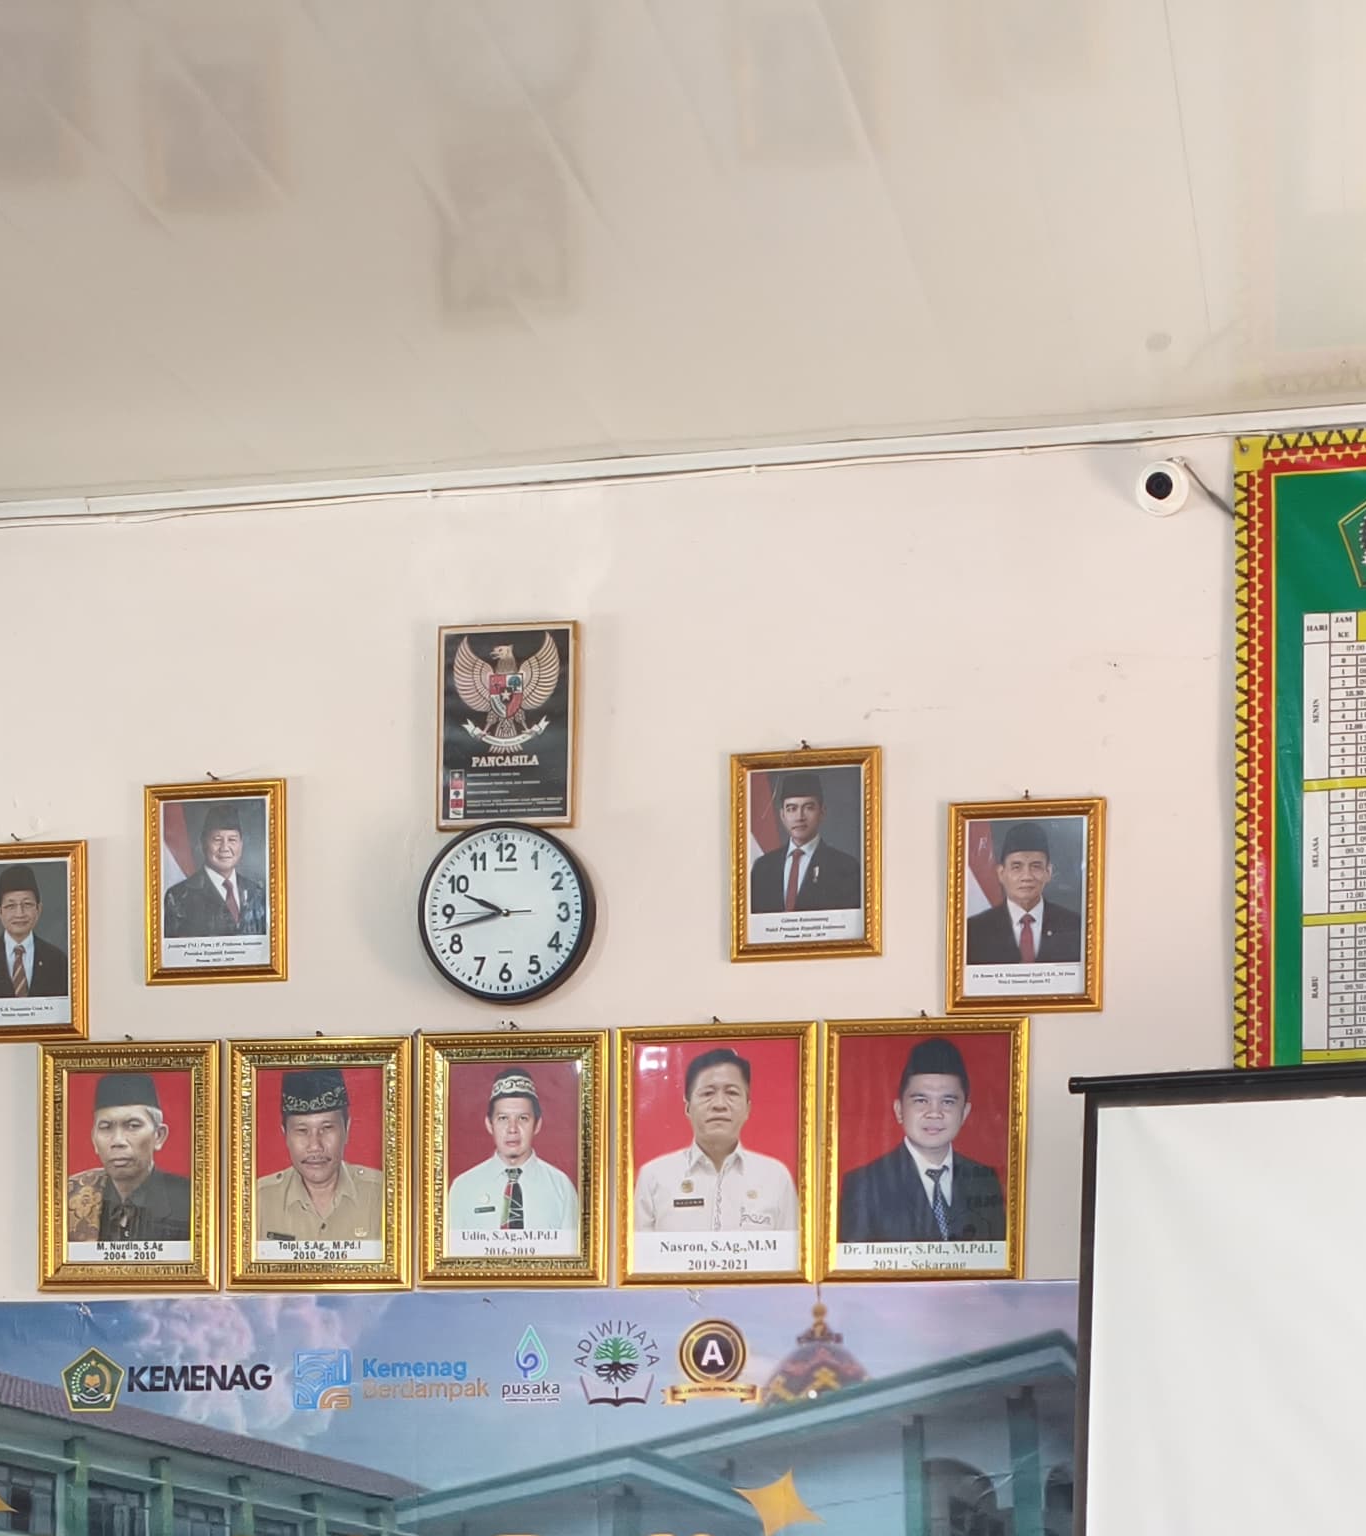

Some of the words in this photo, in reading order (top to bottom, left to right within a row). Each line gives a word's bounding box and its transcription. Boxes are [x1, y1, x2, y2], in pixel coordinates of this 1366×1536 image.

[1306, 624, 1328, 632] HARI
[471, 755, 539, 767] PANCASILA
[470, 852, 487, 871] 11
[495, 843, 516, 861] 12
[531, 851, 539, 870] 1
[448, 875, 469, 894] 10
[551, 872, 564, 891] 2
[442, 903, 456, 923] 9
[557, 902, 571, 922] 3
[449, 934, 463, 954] 8
[548, 931, 562, 953] 4
[473, 957, 486, 976] 7
[499, 962, 512, 983] 6
[528, 955, 541, 974] 5
[462, 1231, 490, 1242] Udin,
[97, 1242, 107, 1250] M.
[110, 1242, 139, 1252] Nurdin,
[144, 1242, 163, 1252] S.Ag
[104, 1252, 126, 1260] 2004
[134, 1252, 156, 1260] 2010
[293, 1251, 315, 1259] 2010
[323, 1251, 347, 1259] 2016
[484, 1247, 535, 1256] 2016-2019
[660, 1241, 707, 1254] Nasron,
[843, 1245, 862, 1254] Dr.
[866, 1245, 912, 1256] Hamsir,
[688, 1260, 748, 1271] 2019-2021
[873, 1260, 898, 1270] 2021
[911, 1260, 966, 1270] Sekarang
[574, 1320, 660, 1368] ADIWIYATA
[701, 1340, 725, 1366] A
[127, 1363, 272, 1393] KEMENAG
[363, 1358, 467, 1380] Kemenag
[363, 1381, 489, 1401] Berdampak
[502, 1382, 561, 1399] pusaka
